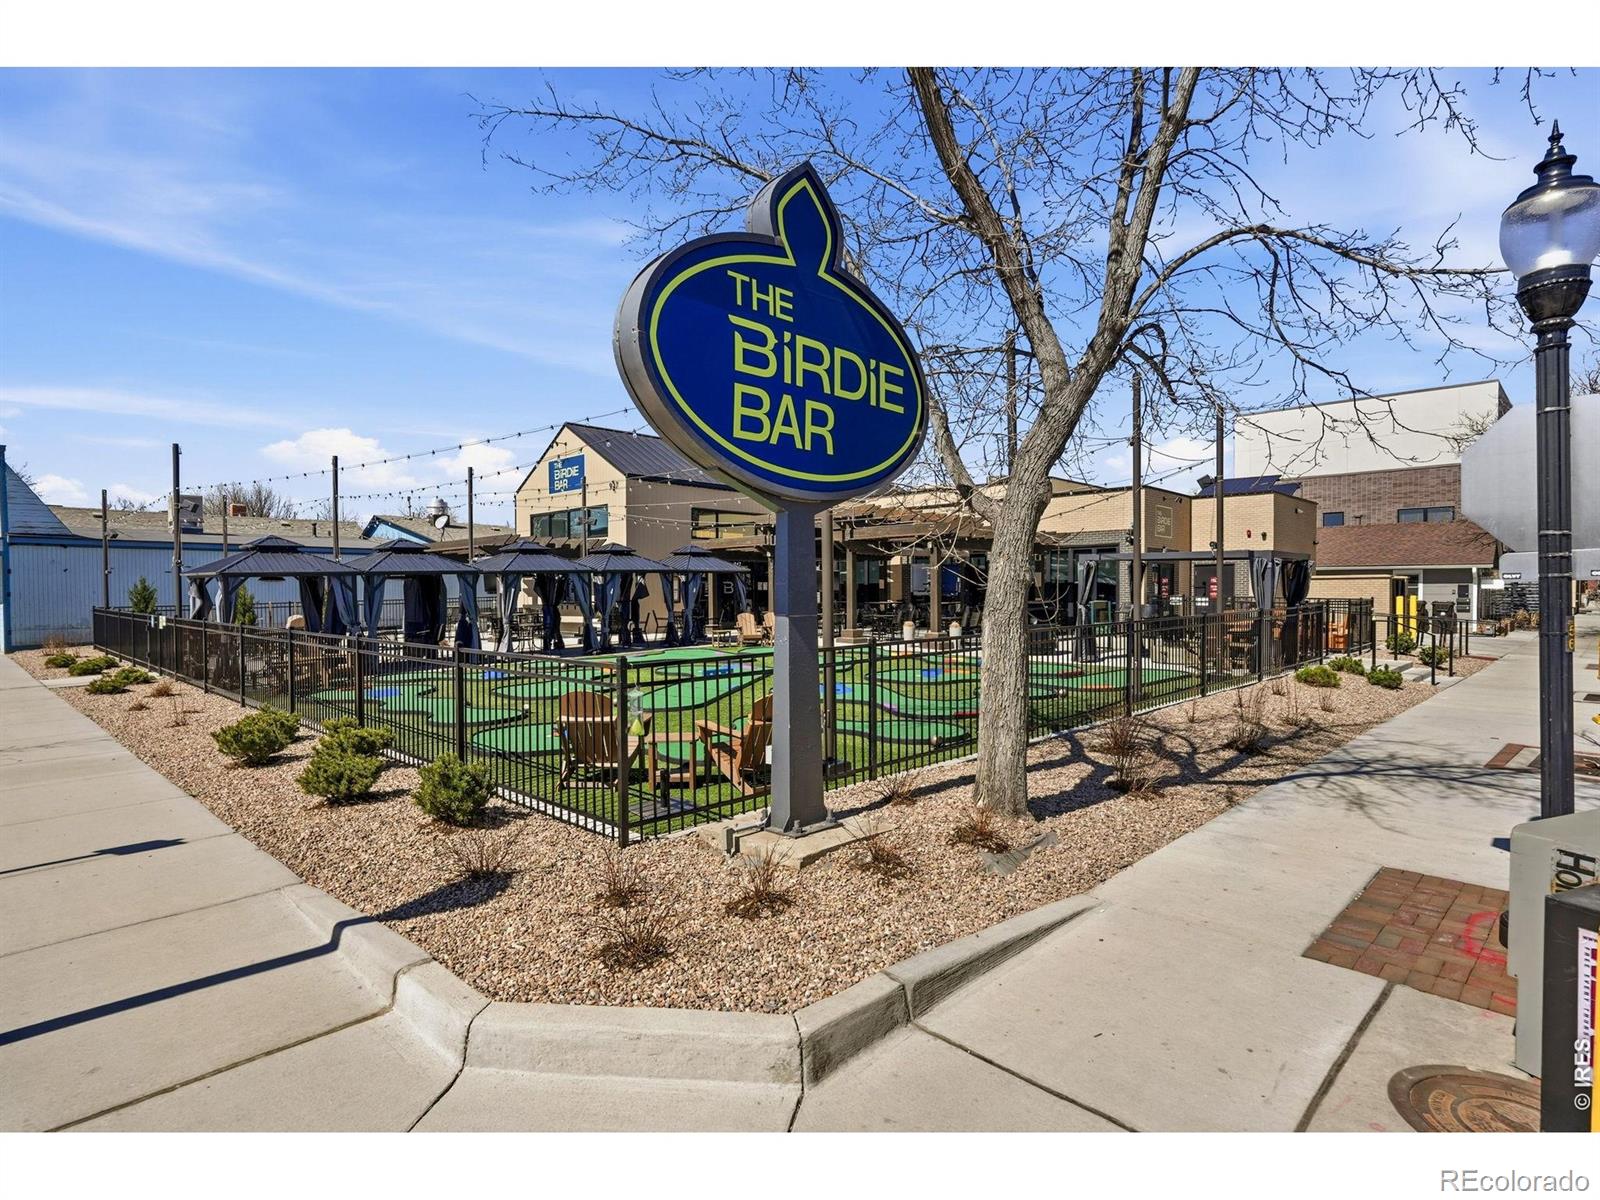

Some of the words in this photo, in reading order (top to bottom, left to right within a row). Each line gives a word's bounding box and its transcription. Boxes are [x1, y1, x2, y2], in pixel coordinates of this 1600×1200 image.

[727, 270, 793, 323] THE
[733, 382, 834, 455] BAR
[554, 479, 568, 491] BAR
